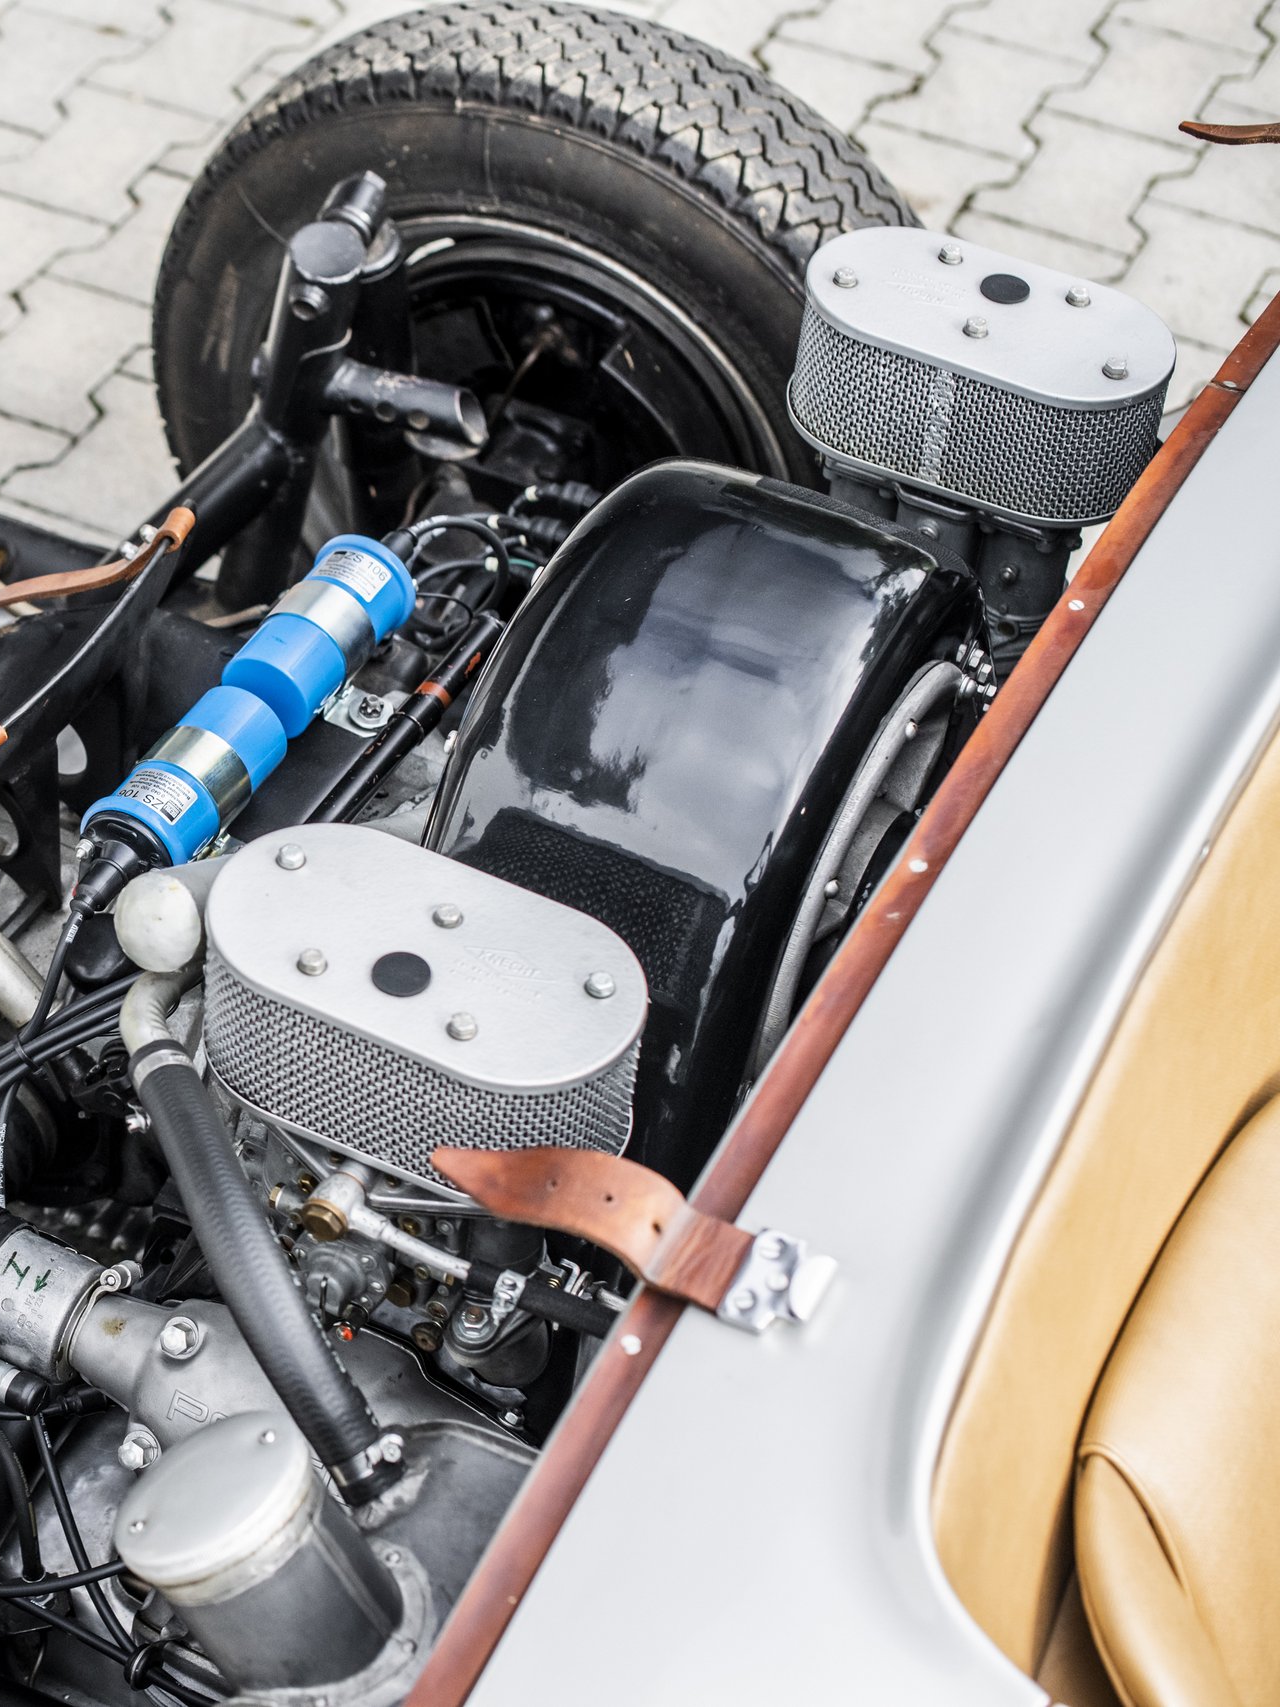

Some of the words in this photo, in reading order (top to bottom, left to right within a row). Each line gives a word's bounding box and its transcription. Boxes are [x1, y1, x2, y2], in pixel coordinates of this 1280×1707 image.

[344, 551, 364, 564] ZS
[367, 561, 388, 582] 106
[119, 789, 140, 799] 106
[142, 794, 164, 810] ZS
